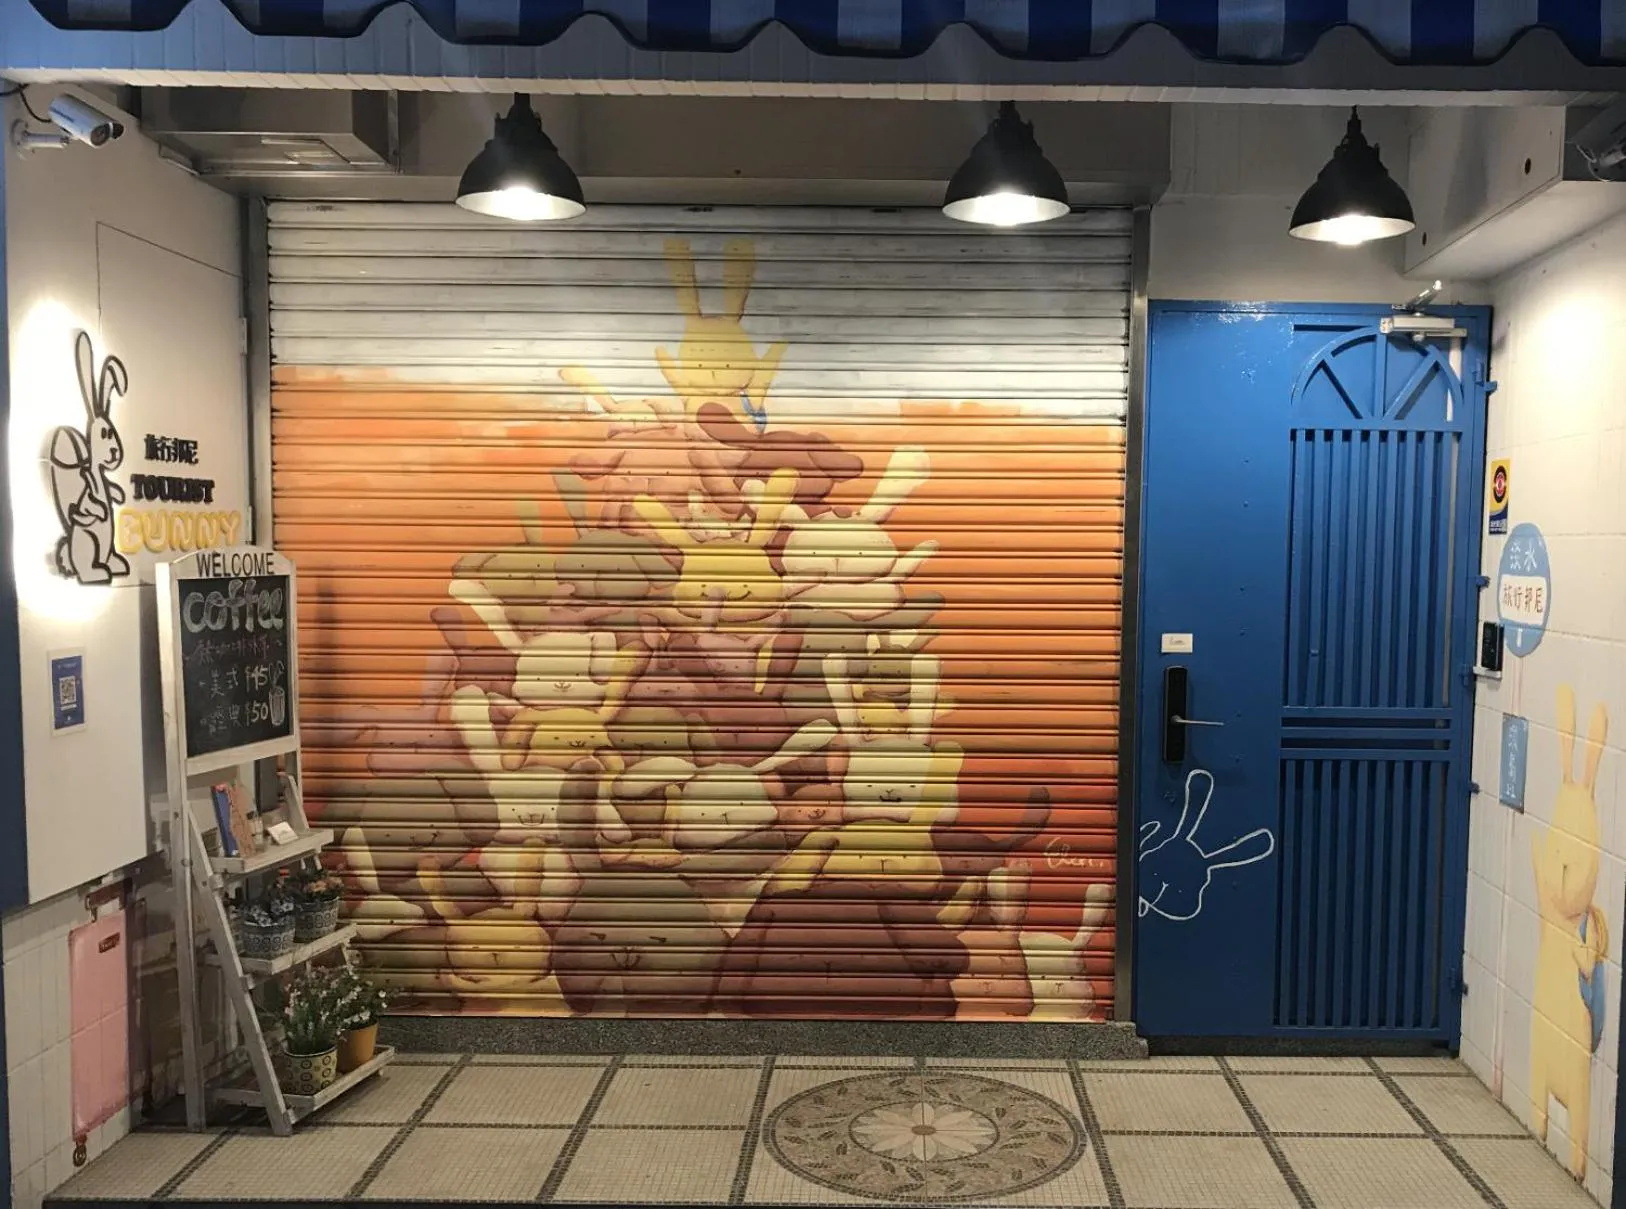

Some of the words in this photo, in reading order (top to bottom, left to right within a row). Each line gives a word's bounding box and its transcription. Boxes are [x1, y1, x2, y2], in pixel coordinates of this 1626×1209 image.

[130, 473, 215, 504] TOURIST
[118, 508, 241, 554] BUNNY
[196, 551, 275, 577] WELCOME
